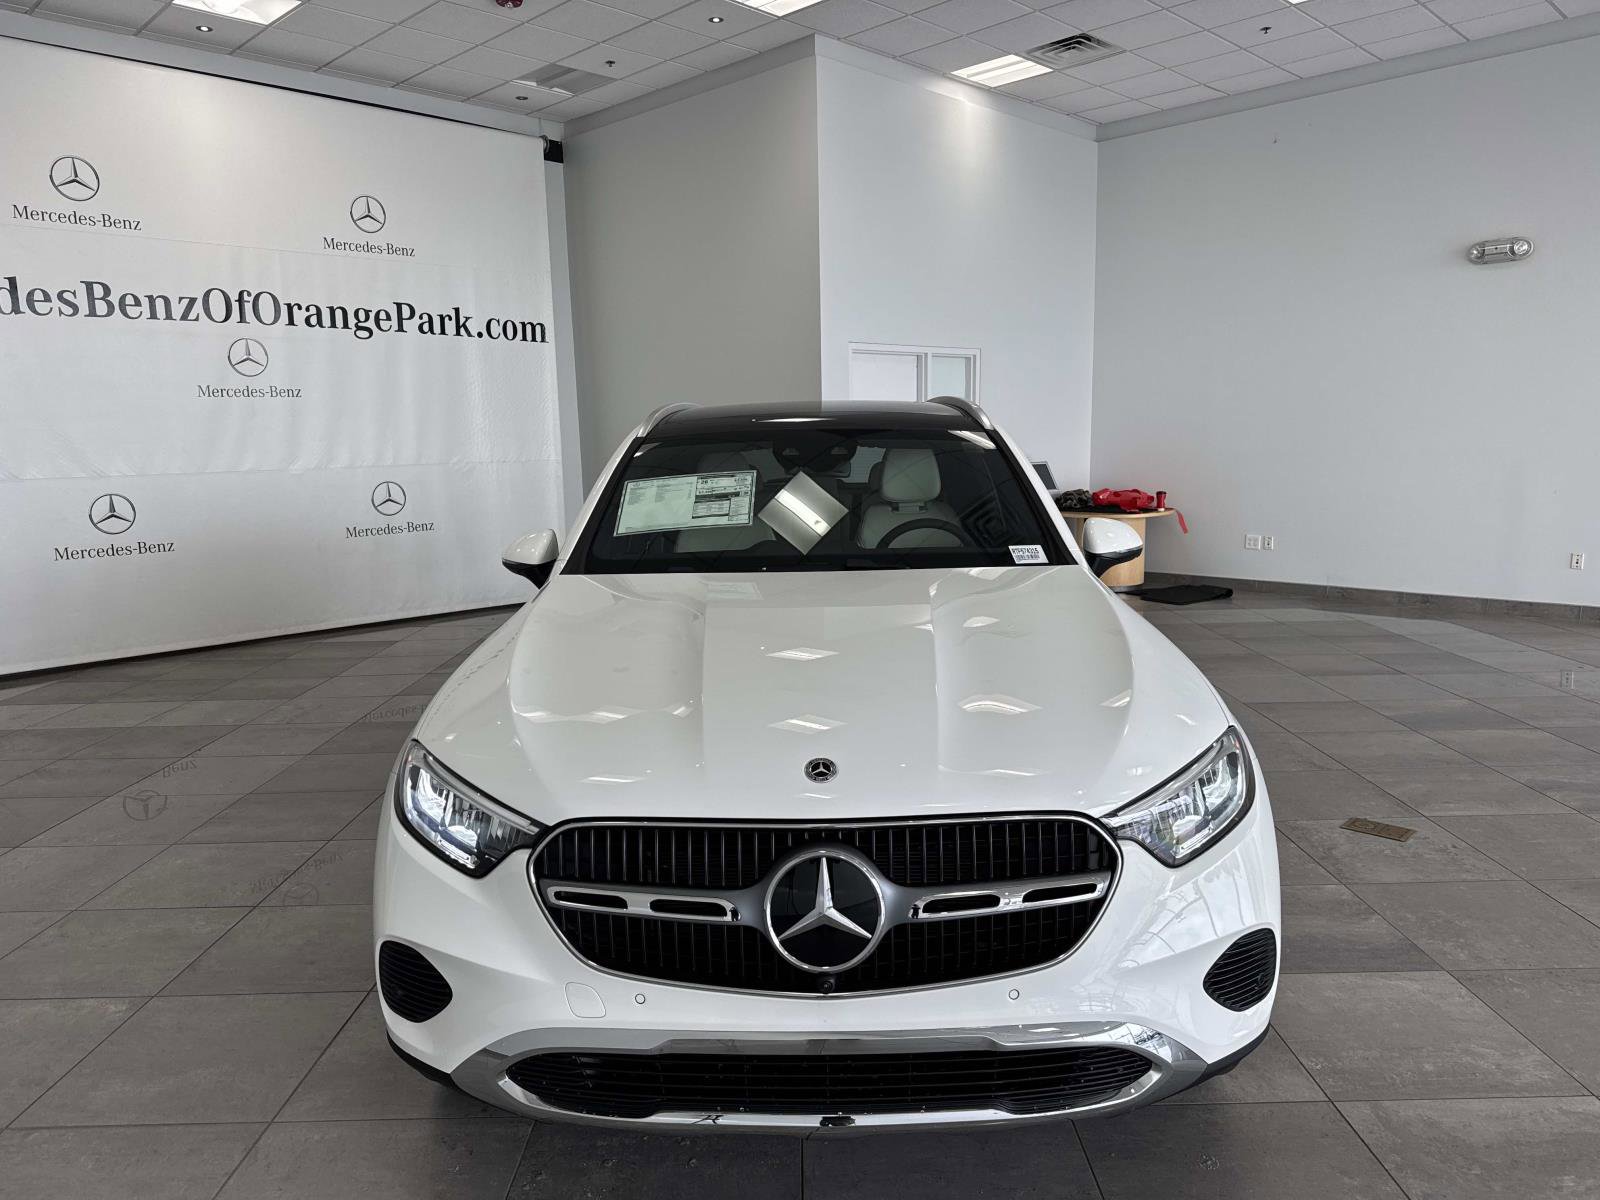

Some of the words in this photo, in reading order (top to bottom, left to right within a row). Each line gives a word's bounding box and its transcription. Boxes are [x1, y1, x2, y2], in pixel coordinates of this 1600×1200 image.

[12, 204, 142, 231] Mercedes-Benz
[323, 236, 416, 257] Mercedes-Benz
[0, 276, 549, 343] desBenzOfOrangePark.com
[197, 384, 302, 399] Mercedes-Benz
[345, 520, 435, 539] Mercedes-Benz
[53, 539, 175, 562] Mercedes-Benz
